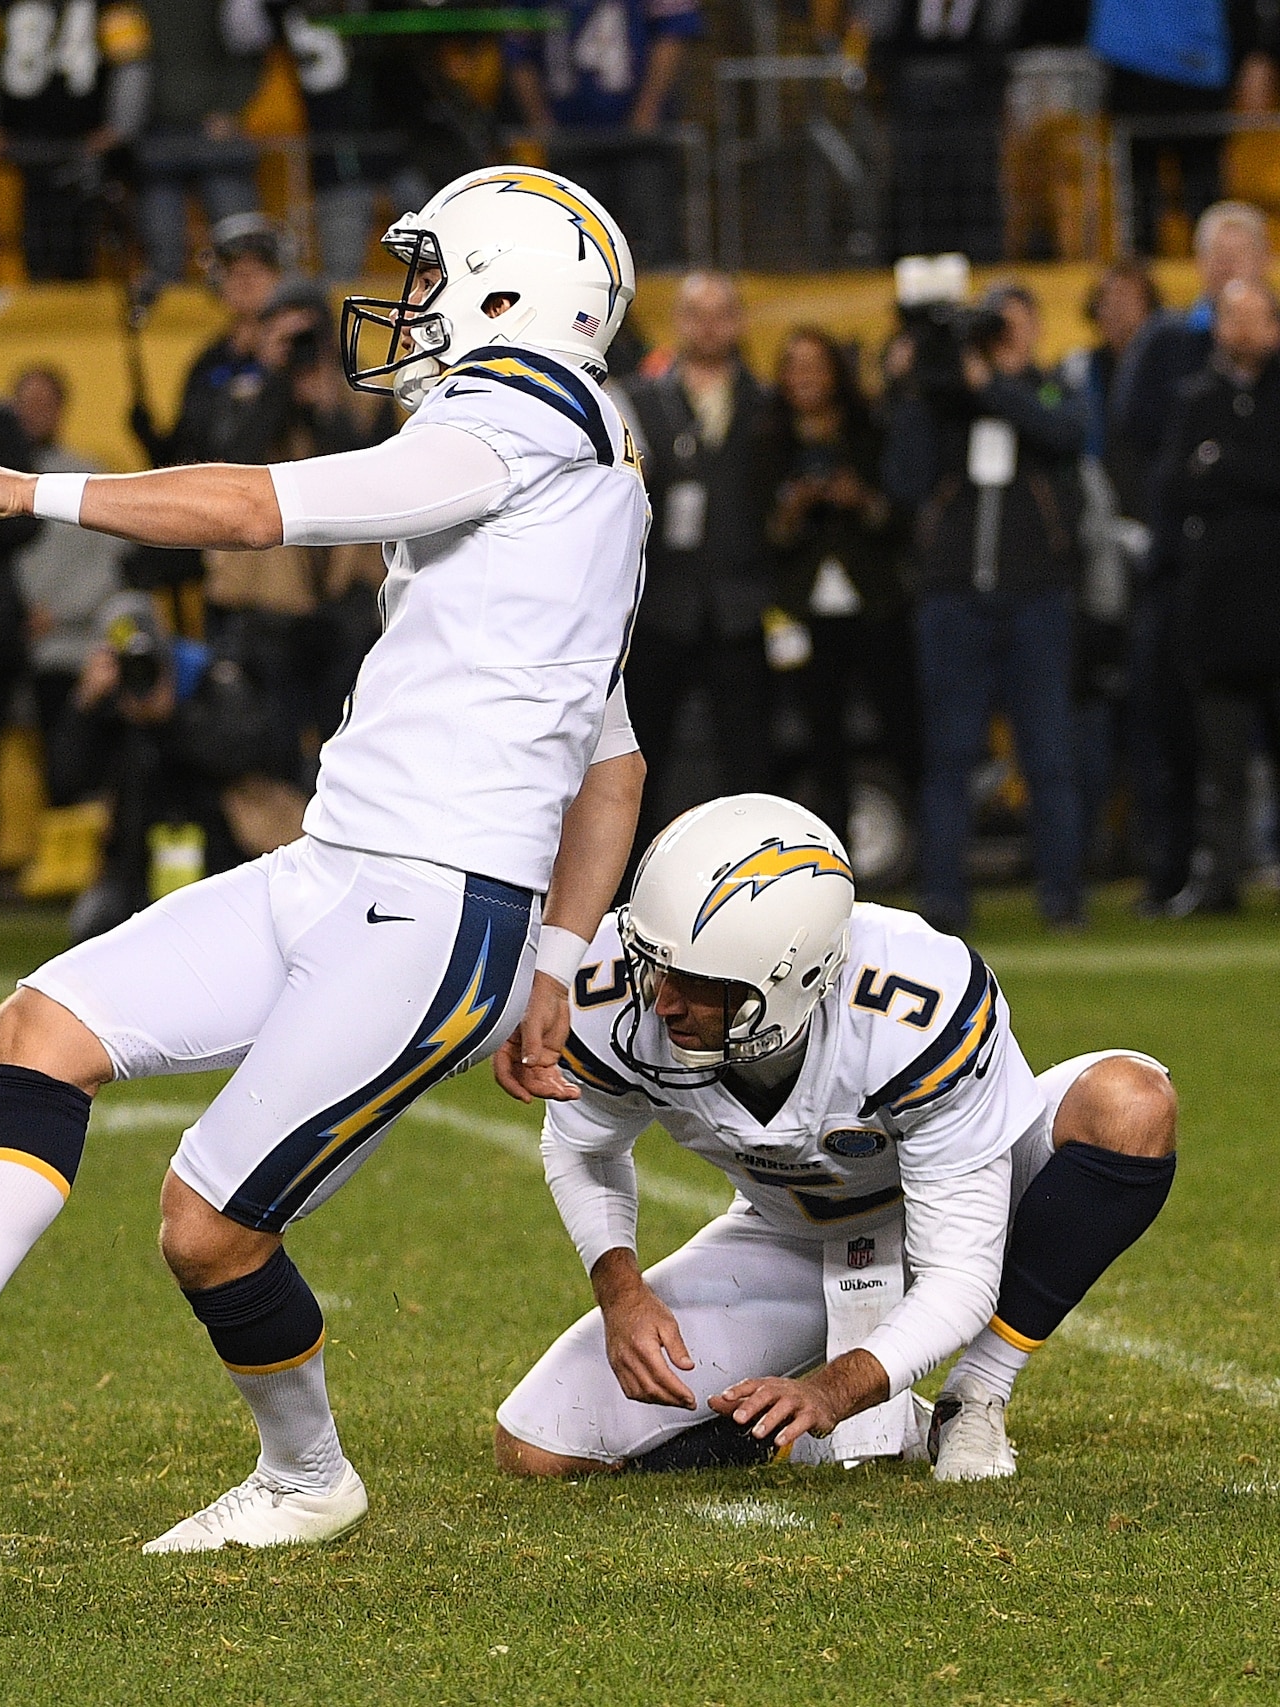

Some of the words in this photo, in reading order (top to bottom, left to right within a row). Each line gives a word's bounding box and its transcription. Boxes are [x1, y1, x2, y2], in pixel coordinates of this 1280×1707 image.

[1, 0, 99, 97] 84
[848, 964, 944, 1031] 5
[849, 1250, 874, 1266] NFL
[839, 1278, 883, 1292] Wilson
